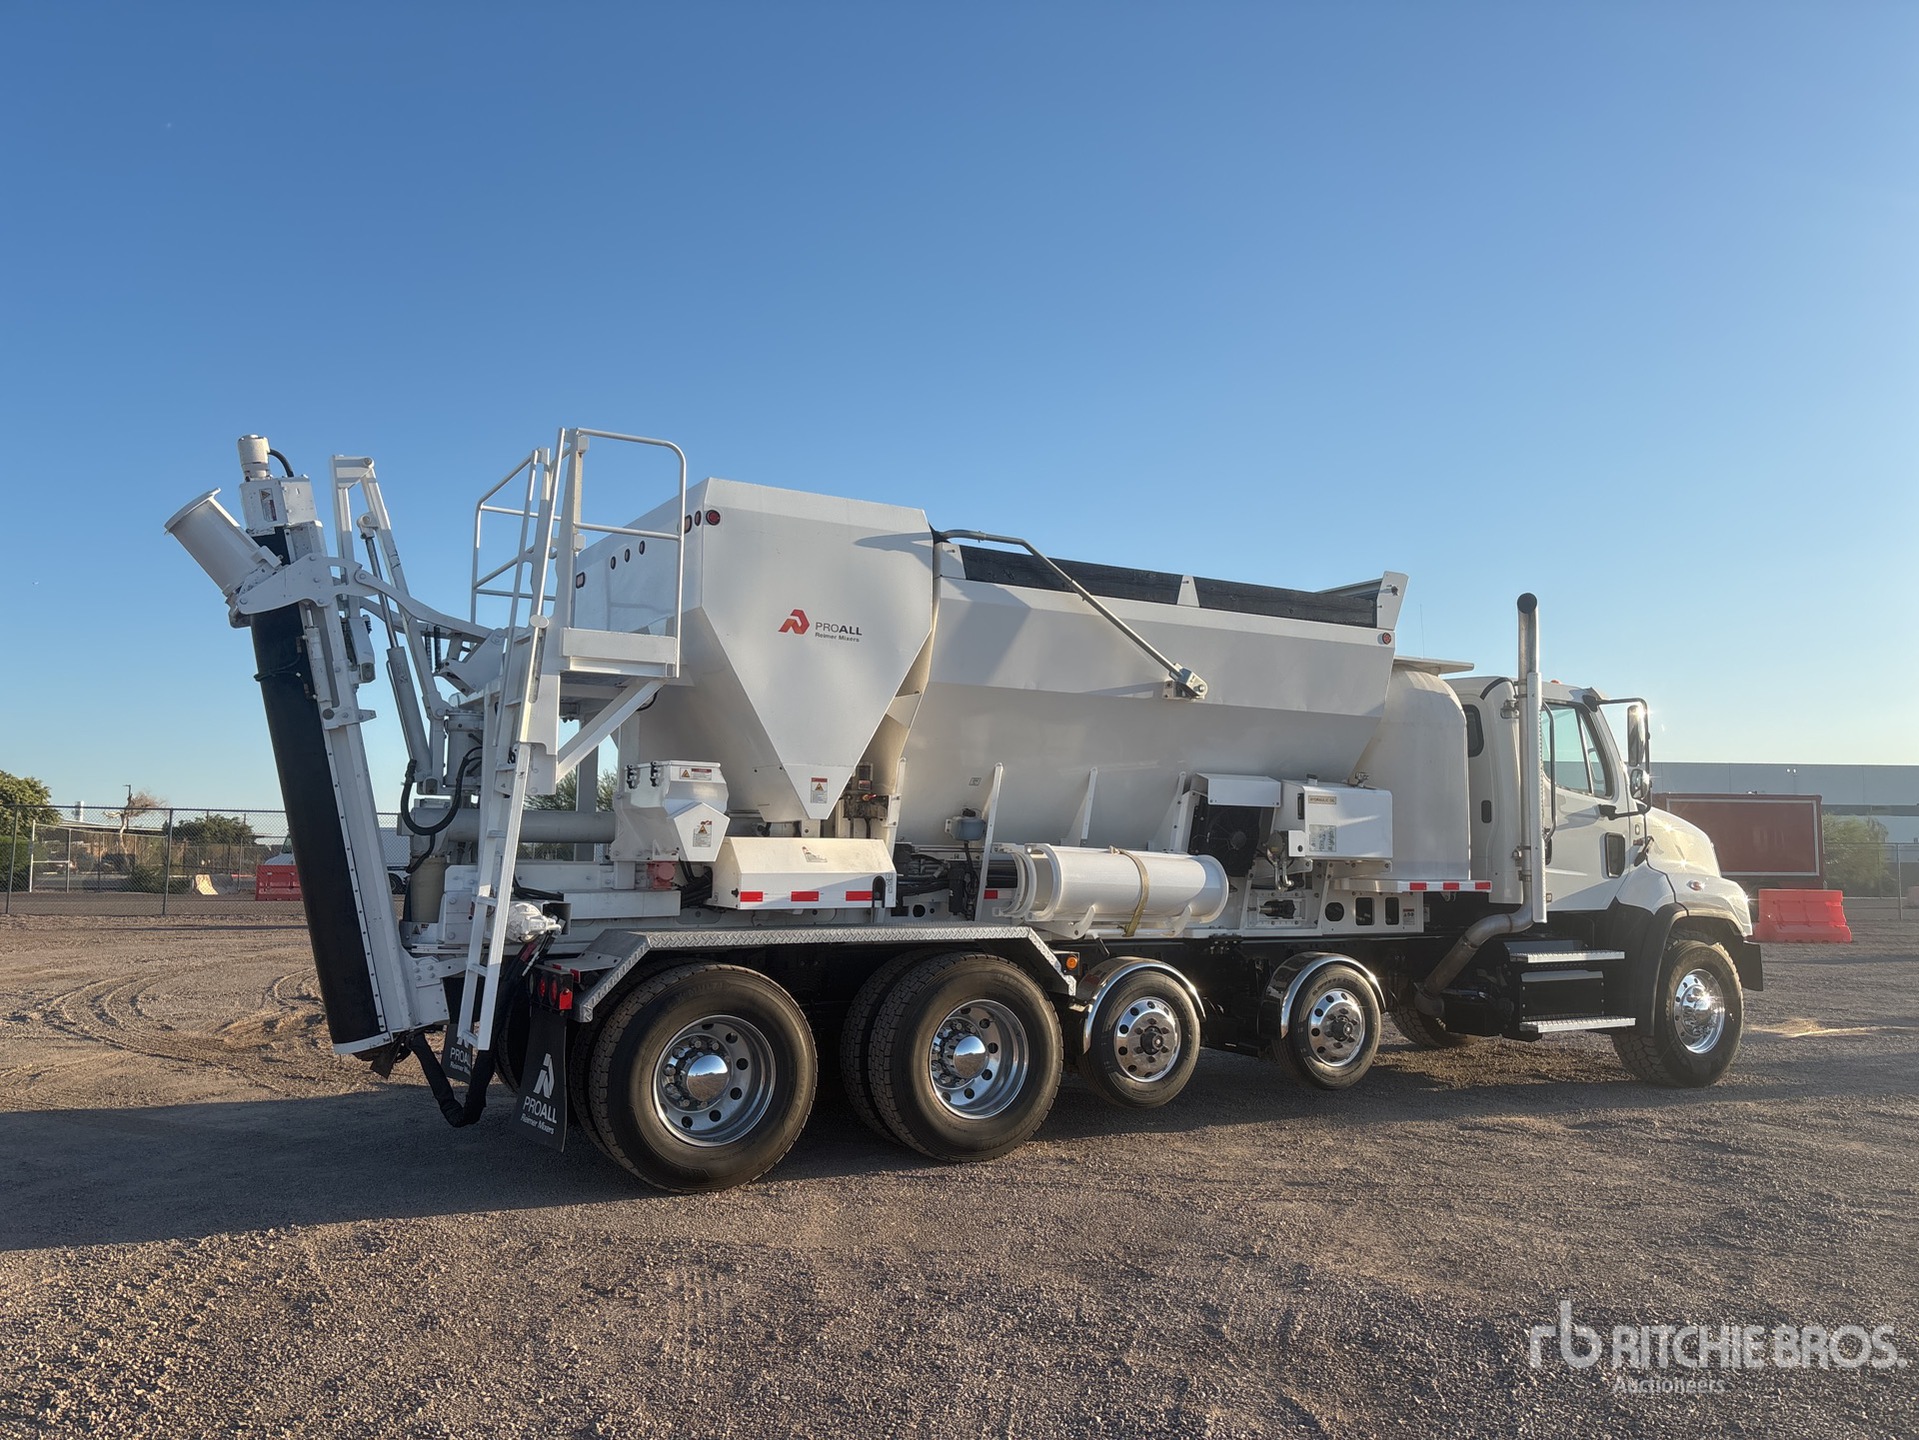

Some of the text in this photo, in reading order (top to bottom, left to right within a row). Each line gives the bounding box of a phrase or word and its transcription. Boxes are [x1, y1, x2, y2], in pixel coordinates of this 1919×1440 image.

[815, 621, 862, 636] PROALL
[838, 634, 860, 643] Mixers
[522, 1096, 557, 1124] PROALL
